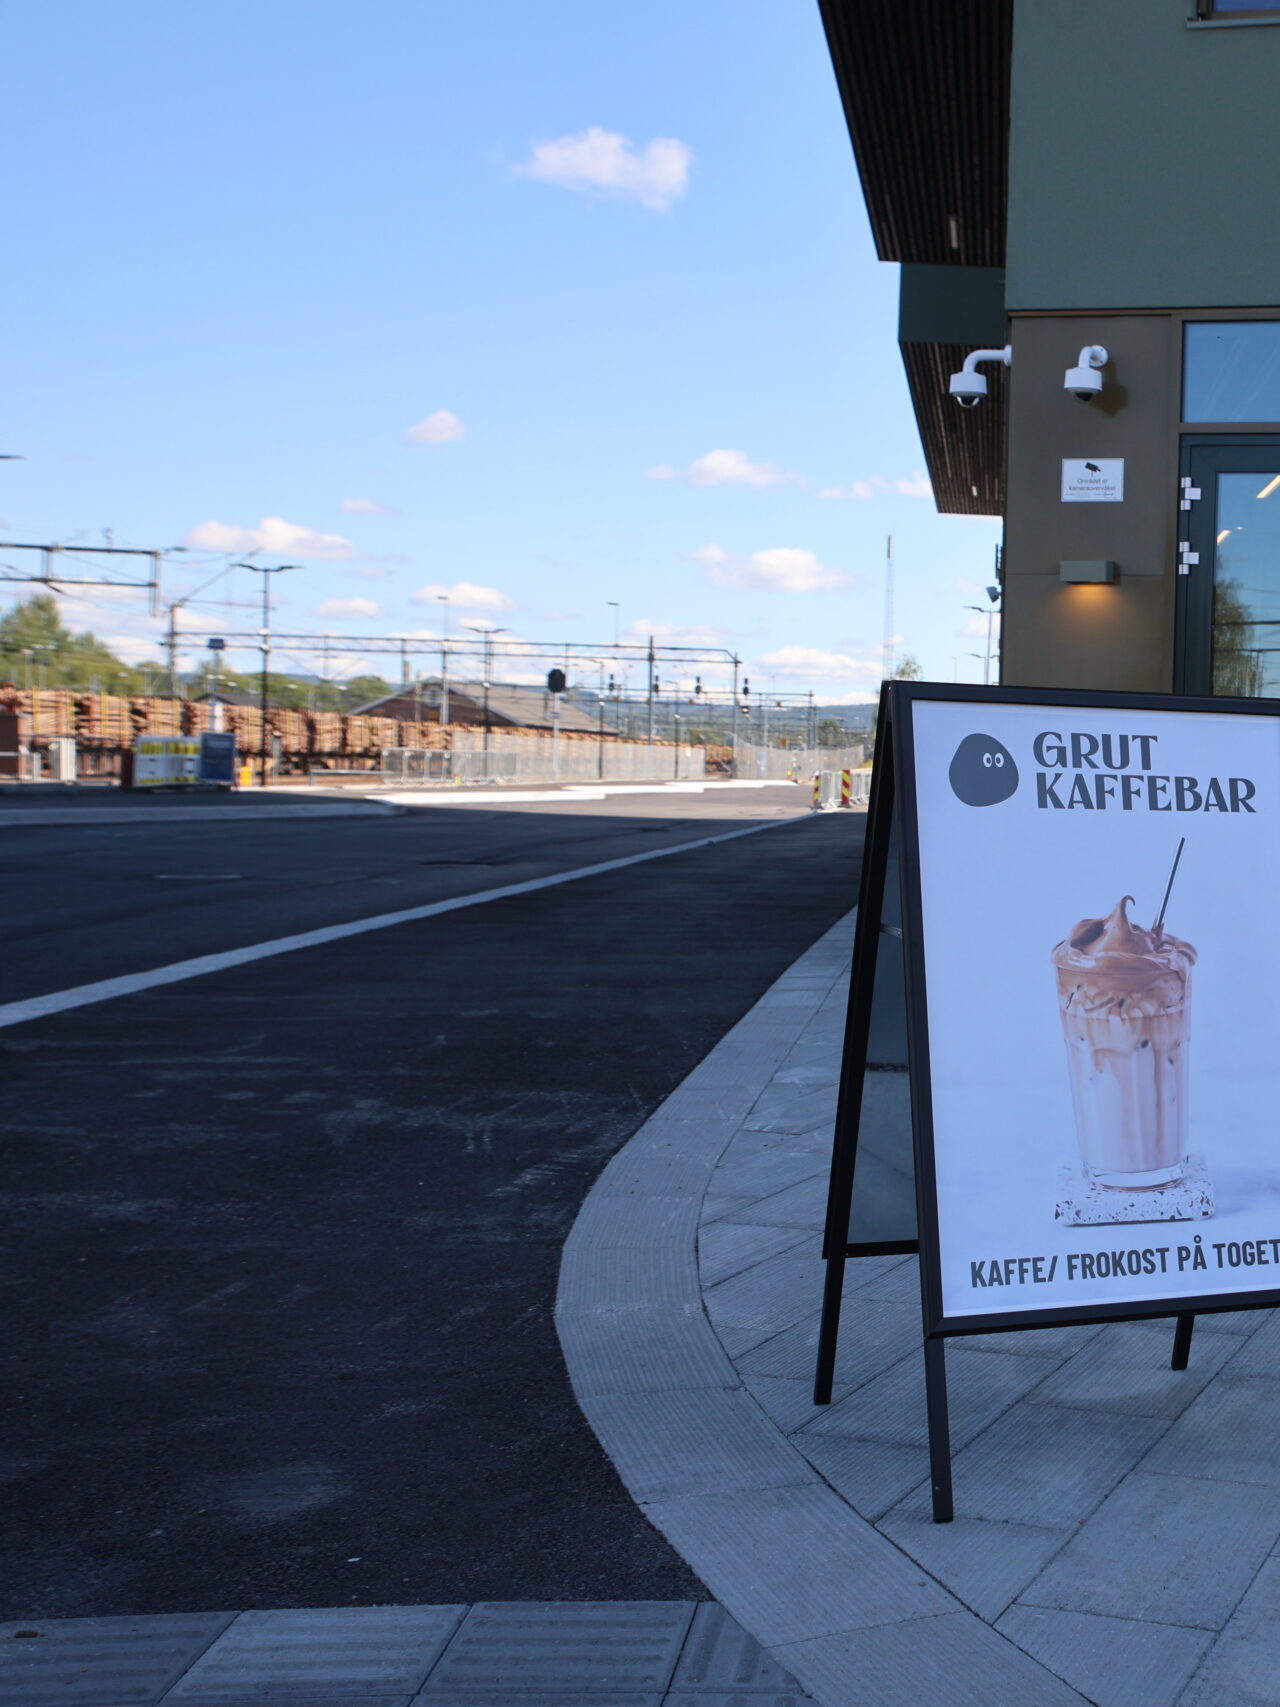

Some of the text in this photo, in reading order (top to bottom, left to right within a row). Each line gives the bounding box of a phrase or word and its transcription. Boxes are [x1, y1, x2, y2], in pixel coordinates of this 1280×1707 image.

[1033, 731, 1158, 770] GRUT
[1036, 772, 1257, 813] KAFFEBAR
[970, 1256, 1058, 1288] KAFFE/
[1067, 1247, 1170, 1281] FROKOST
[1177, 1234, 1207, 1271] PÅ
